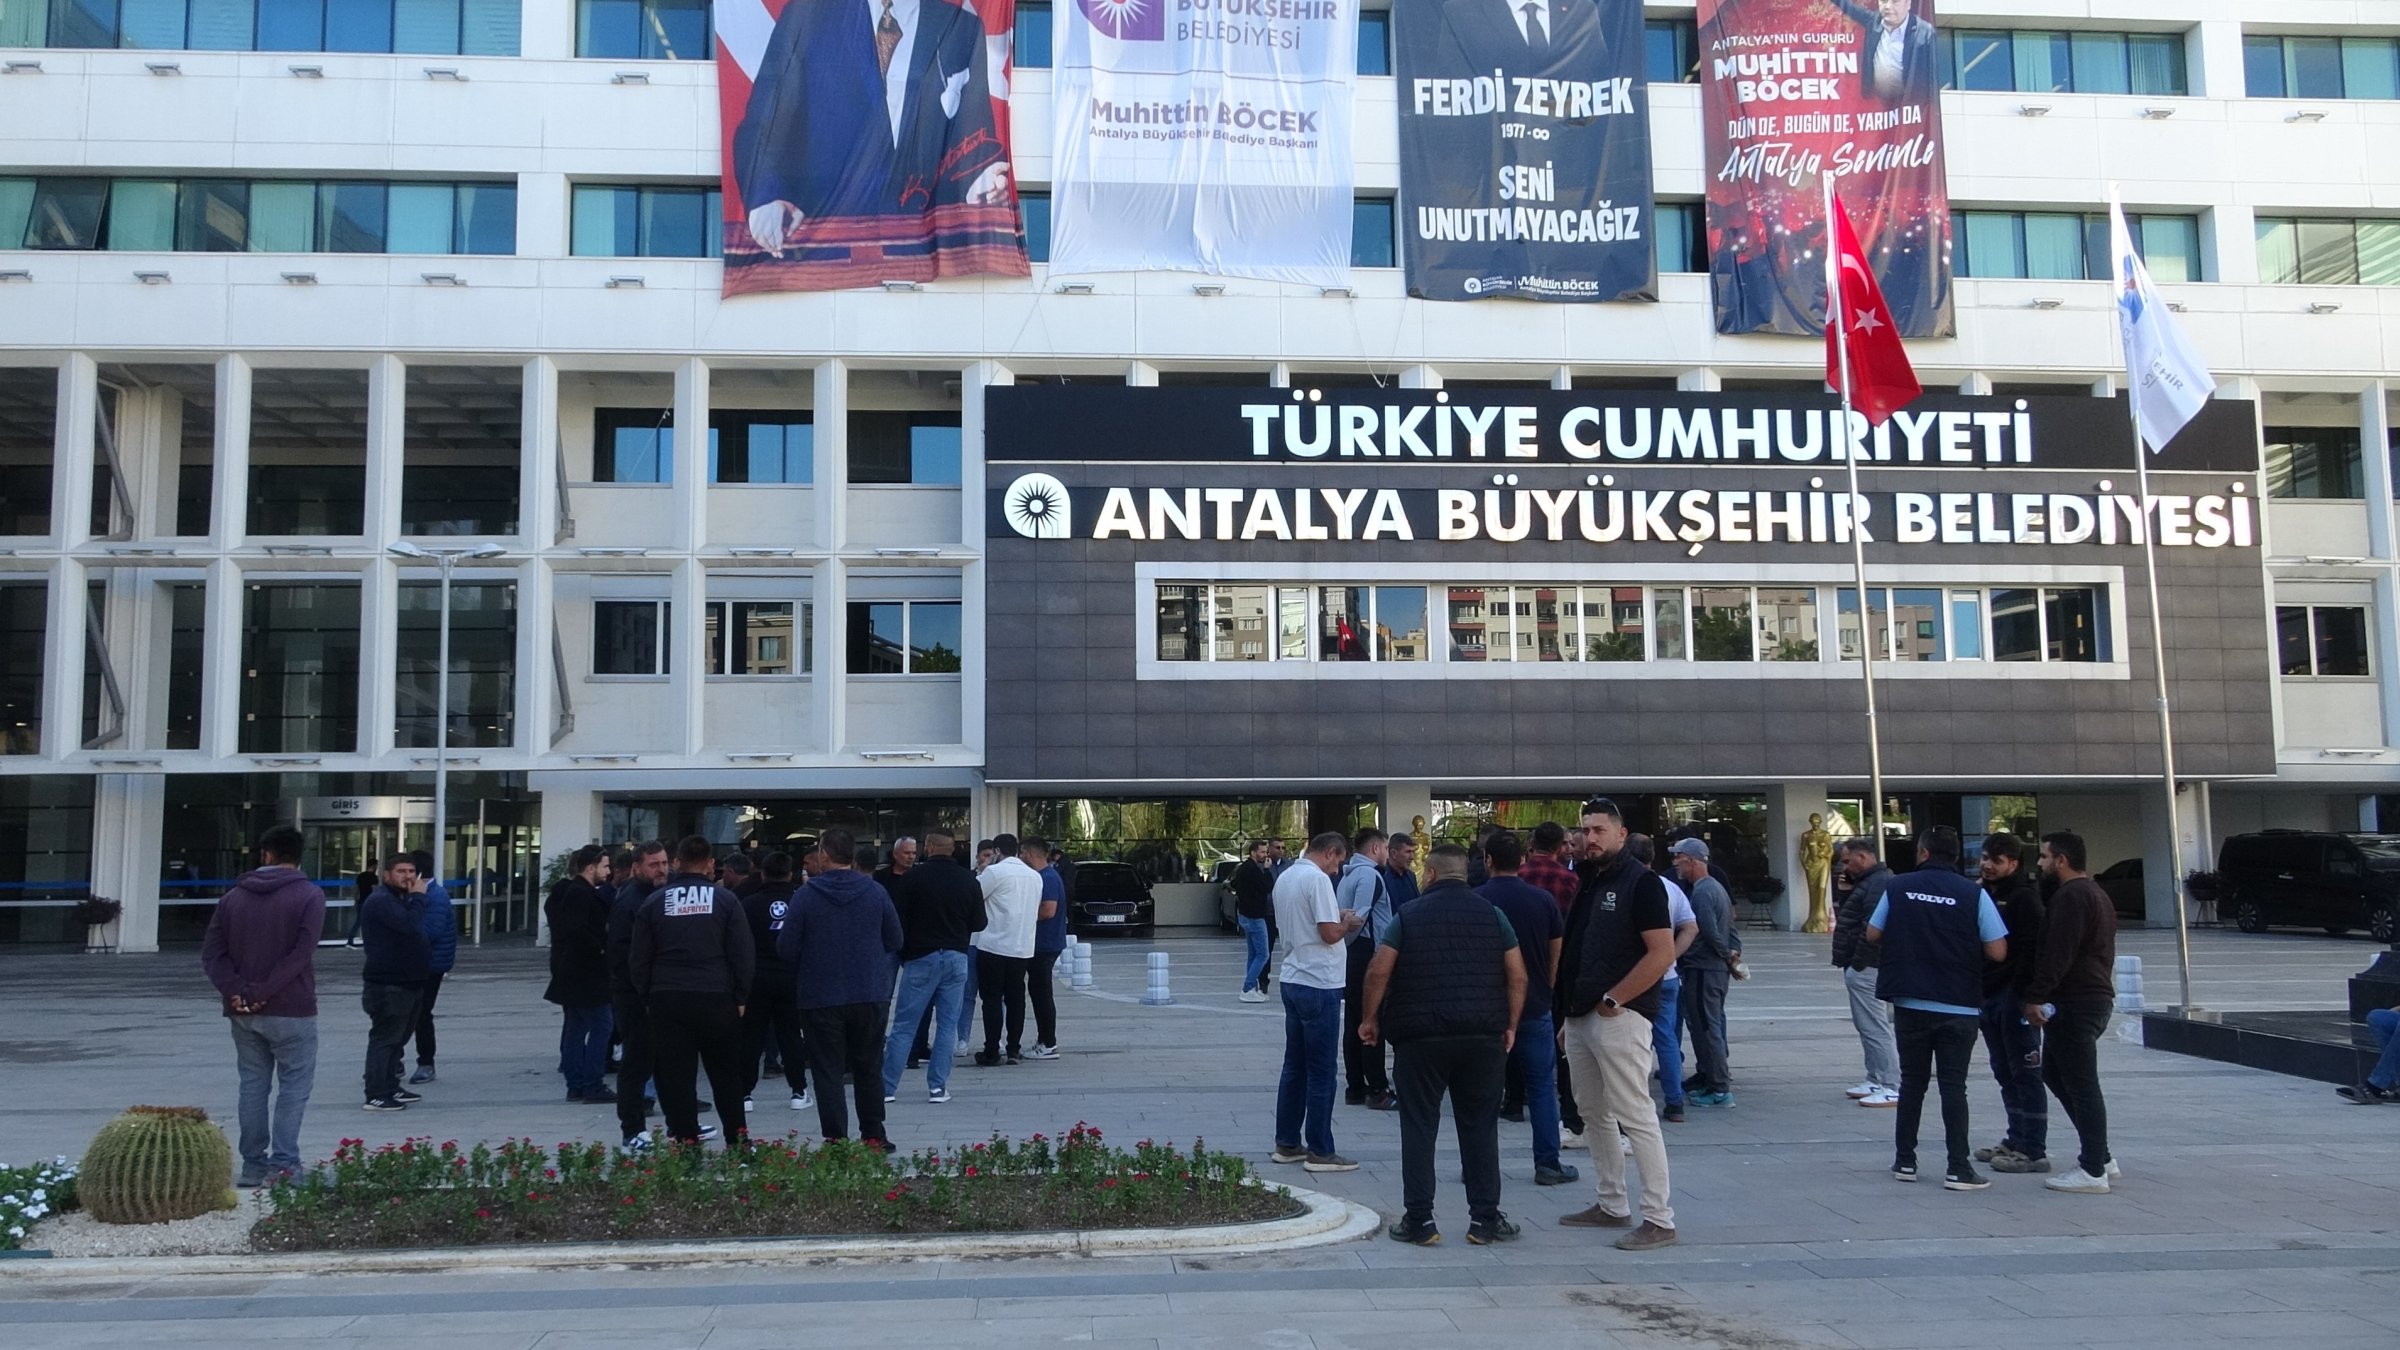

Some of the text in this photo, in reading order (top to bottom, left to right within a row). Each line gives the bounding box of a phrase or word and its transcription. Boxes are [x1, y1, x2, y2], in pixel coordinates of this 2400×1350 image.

[1177, 20, 1300, 49] BELEDİYESİ
[1712, 32, 1855, 50] ANTALYA'NIN GURURU
[1714, 47, 1858, 80] MUHİTTİN
[1413, 68, 1634, 118] FERDİ ZEYREK
[1736, 75, 1840, 104] BÖCEK
[1091, 97, 1318, 133] Muhittin BÖCEK
[1728, 105, 1922, 140] DÜN DE, BUGÜN DE, YARIN DA
[1089, 125, 1318, 149] Antalya Büyükşehir Belediye Başkanı
[1718, 133, 1935, 187] Antalya Seninle
[1498, 160, 1555, 201] SENİ
[1418, 200, 1640, 243] UNUTMAYACAĞIZ
[1562, 279, 1599, 290] BÖCEK
[1241, 388, 2032, 462] TÜRKİYE CUMHURİYETİ
[1092, 474, 2252, 557] ANTALYA BÜYÜKŞEHİR BELEDİYESİ
[672, 885, 715, 905] CAN
[1905, 892, 1956, 906] VOLVO
